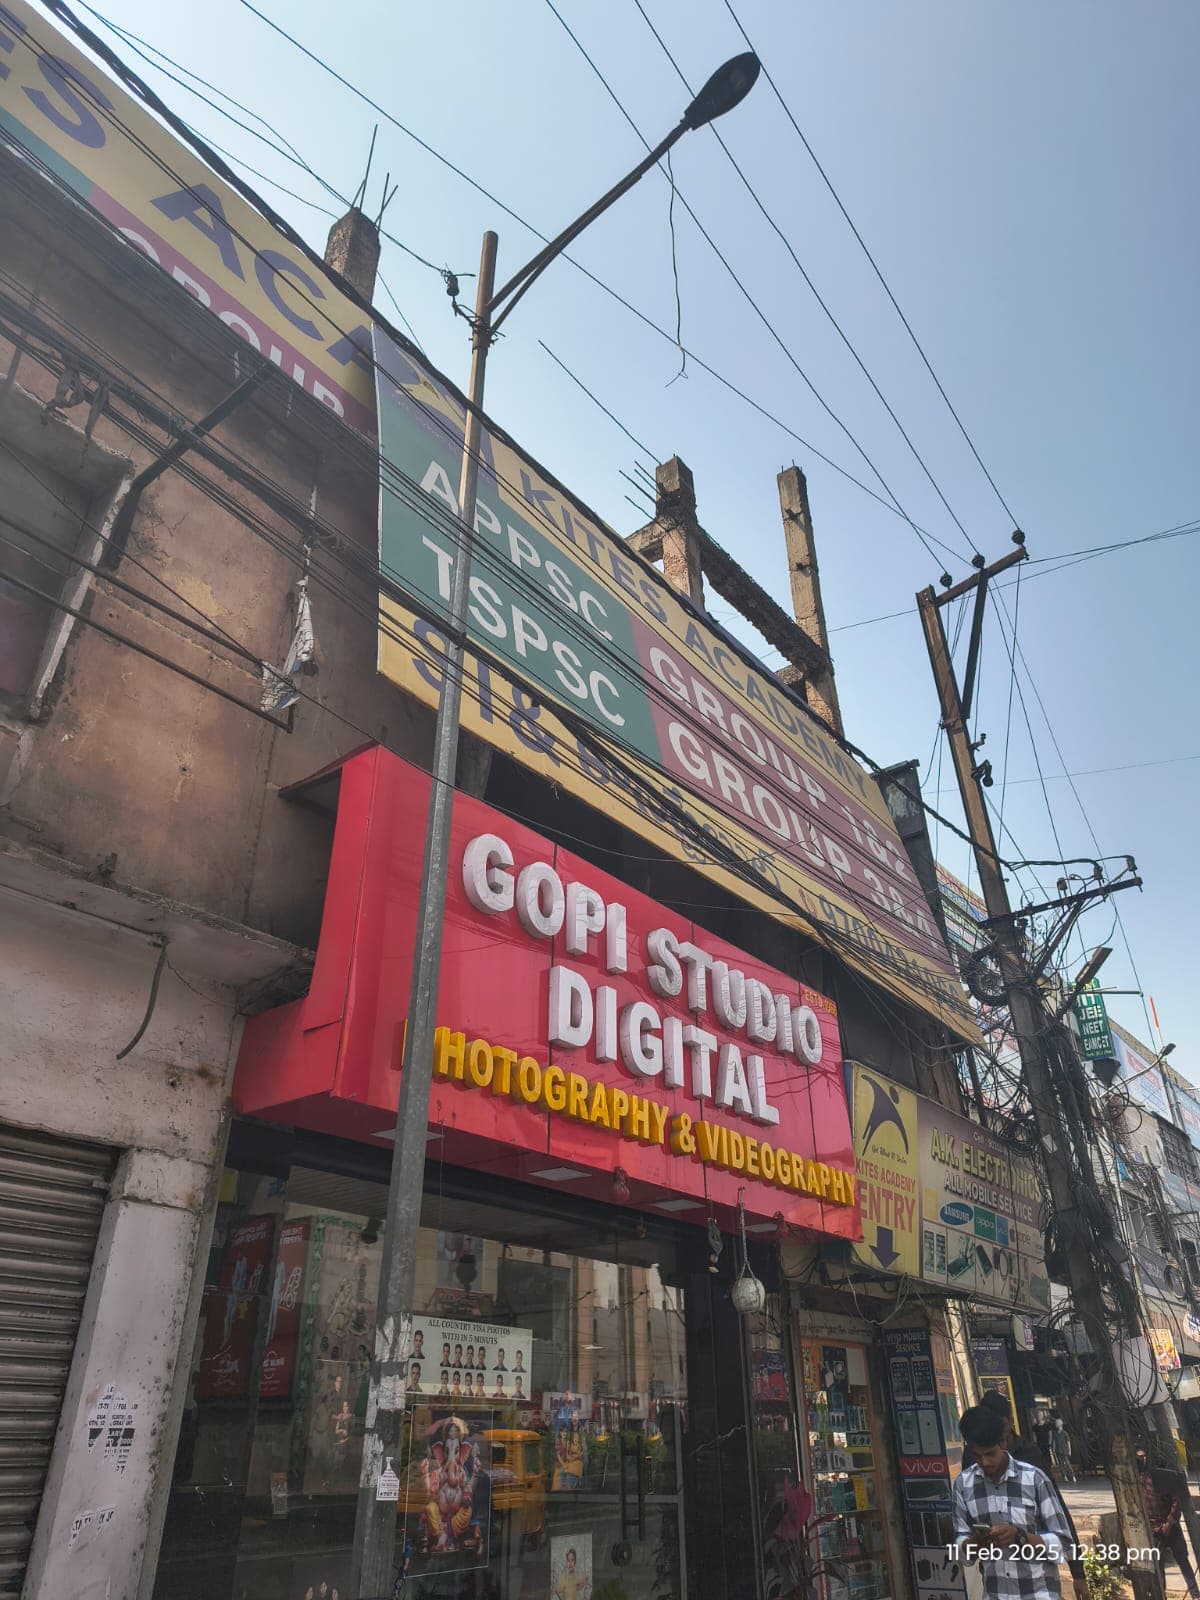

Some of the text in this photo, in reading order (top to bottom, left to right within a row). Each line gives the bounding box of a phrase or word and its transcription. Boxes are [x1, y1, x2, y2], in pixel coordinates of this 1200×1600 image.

[419, 460, 615, 642] APPSC
[650, 646, 828, 809] GROUP
[422, 535, 626, 727] TSPSC
[668, 721, 852, 883] GROUP
[520, 468, 868, 800] KITES ACADEMY
[463, 833, 628, 975] GOPI
[646, 927, 823, 1067] STUDIO
[1083, 1020, 1104, 1036] NEET
[401, 1018, 857, 1207] HOTOGRAPHY & VIDEOGRAPHY
[548, 964, 780, 1126] DIGITAL
[855, 1156, 916, 1194] KITES ACADEMY
[856, 1179, 916, 1234] ENTRY
[944, 1169, 1033, 1223] ALL MOBILE SERVICE
